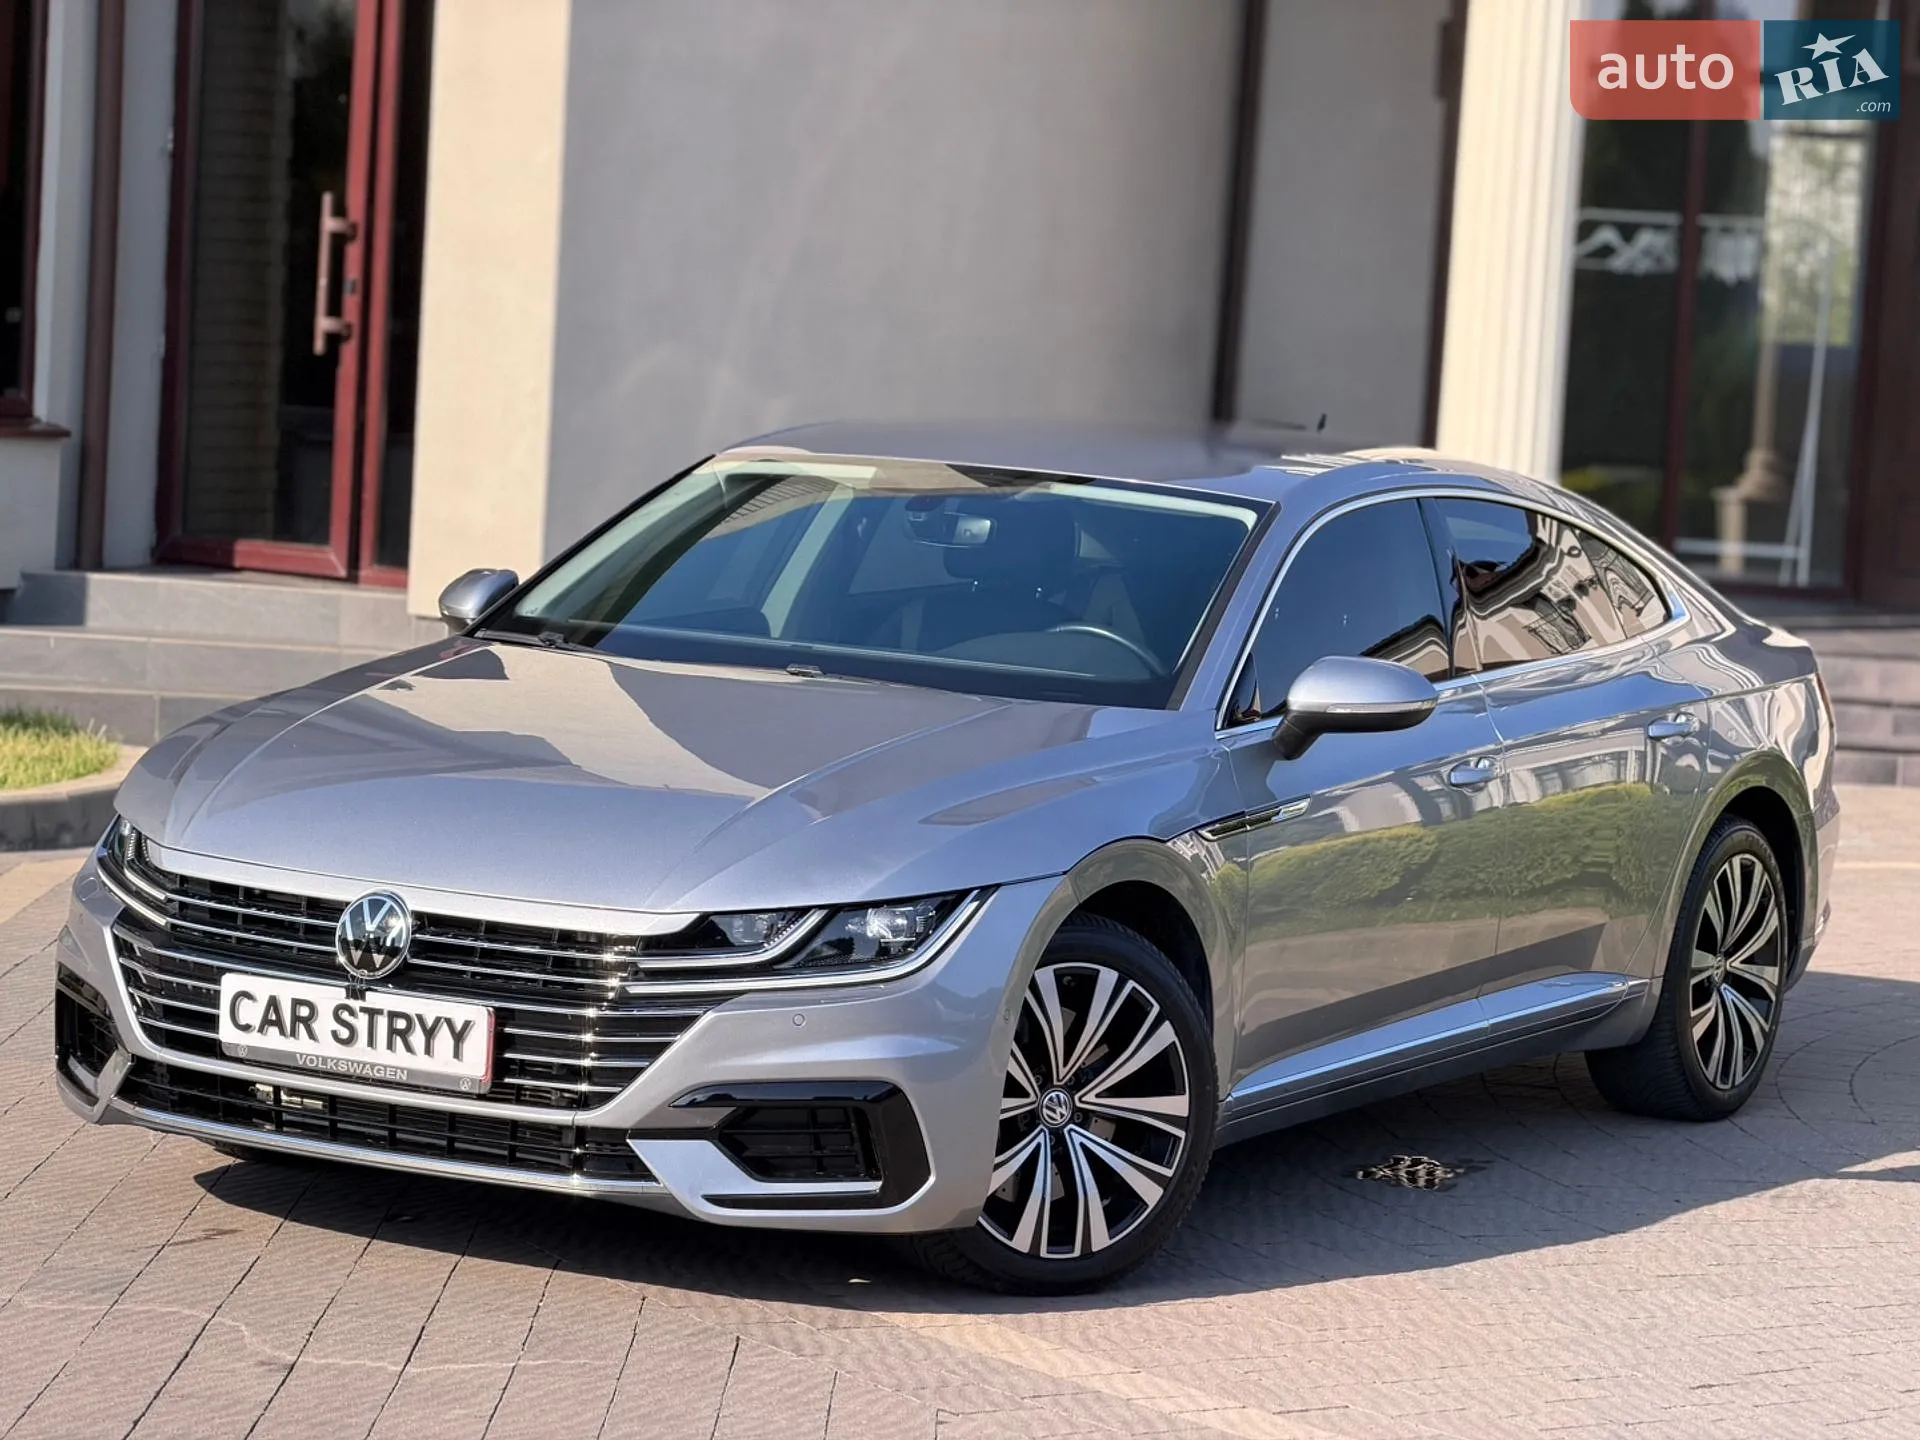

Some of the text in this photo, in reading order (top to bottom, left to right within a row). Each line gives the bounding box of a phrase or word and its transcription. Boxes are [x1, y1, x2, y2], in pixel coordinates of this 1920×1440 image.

[229, 990, 475, 1062] CAR STRYY
[296, 1053, 408, 1081] VOLKSWAGEN
